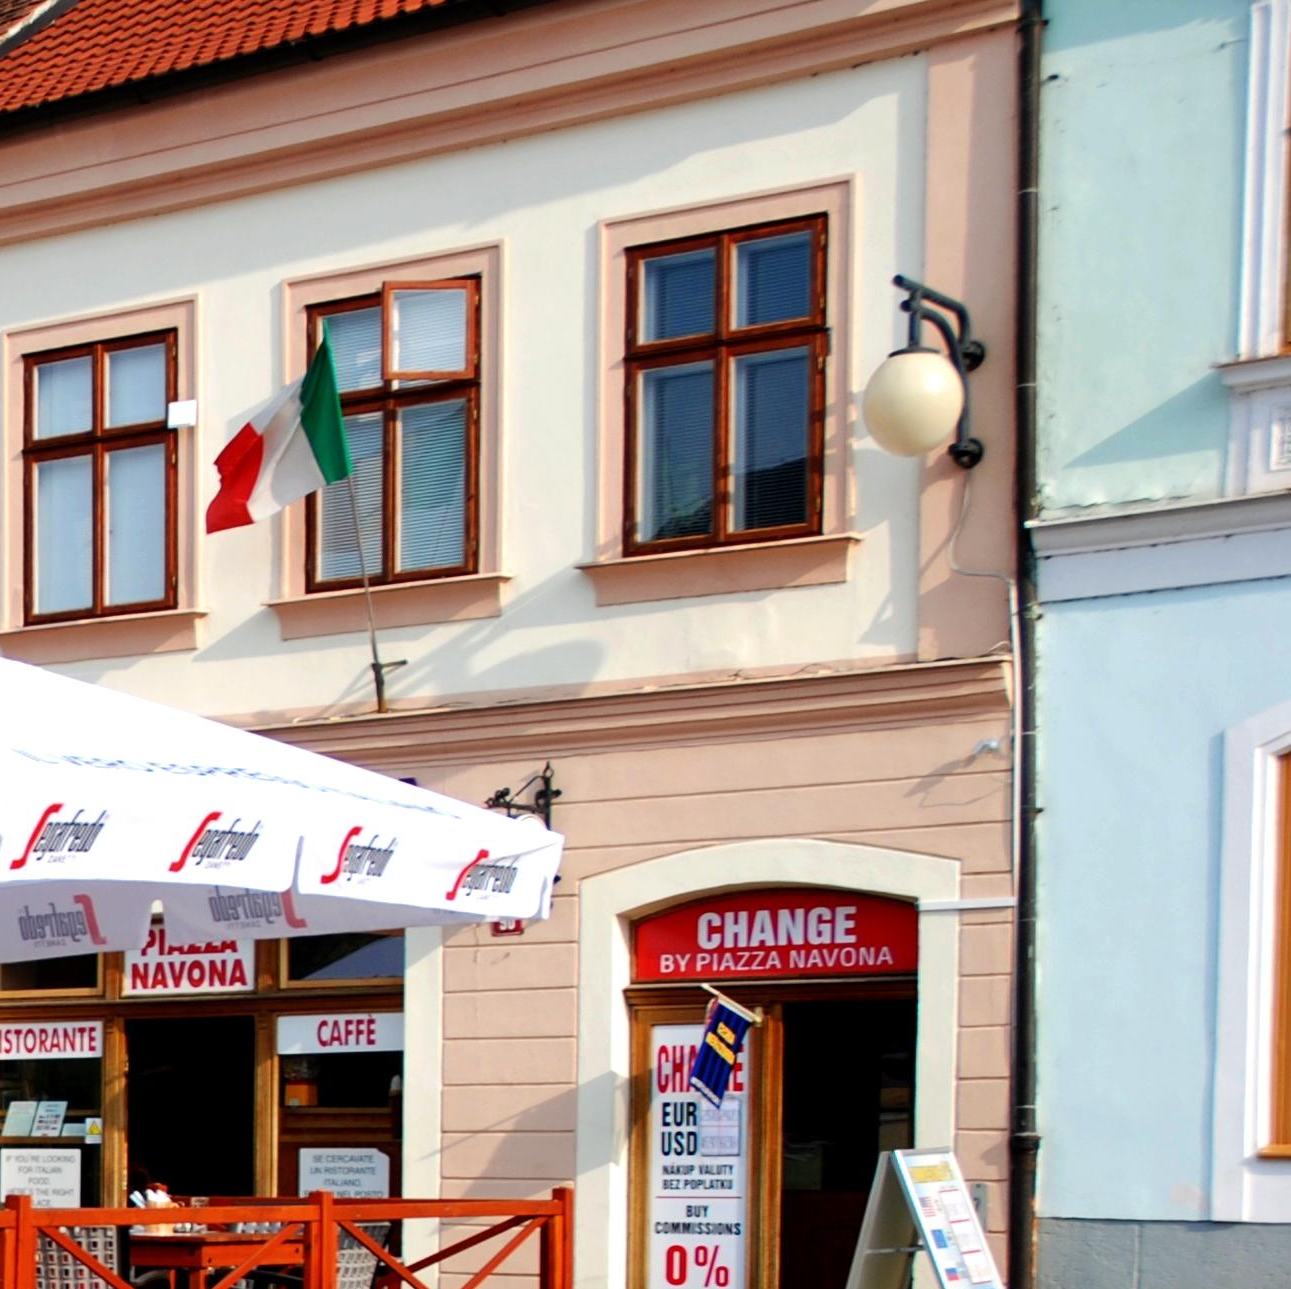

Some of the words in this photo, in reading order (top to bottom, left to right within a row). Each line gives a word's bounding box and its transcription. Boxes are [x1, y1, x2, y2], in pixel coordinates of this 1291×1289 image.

[10, 803, 107, 870] Segafredo
[168, 811, 262, 872] Segafredo
[697, 906, 859, 950] CHANGE
[660, 953, 691, 974] BY
[695, 950, 781, 972] PIAZZA
[789, 946, 894, 969] NAVONA
[131, 958, 248, 990] NAVONA
[317, 1014, 376, 1047] CAFFÈ
[662, 1102, 698, 1127] EUR
[661, 1131, 698, 1156] USD
[18, 1166, 34, 1175] FOR
[34, 1166, 63, 1175] ITALIAN
[42, 1155, 76, 1163] LOOKING
[662, 1163, 695, 1175] NÁKUP
[699, 1165, 734, 1176] VALUTY
[35, 1188, 49, 1196] THE
[663, 1180, 680, 1190] BEZ
[684, 1179, 733, 1190] POPLATKU
[686, 1205, 709, 1217] BUY
[654, 1222, 742, 1236] COMMISSIONS
